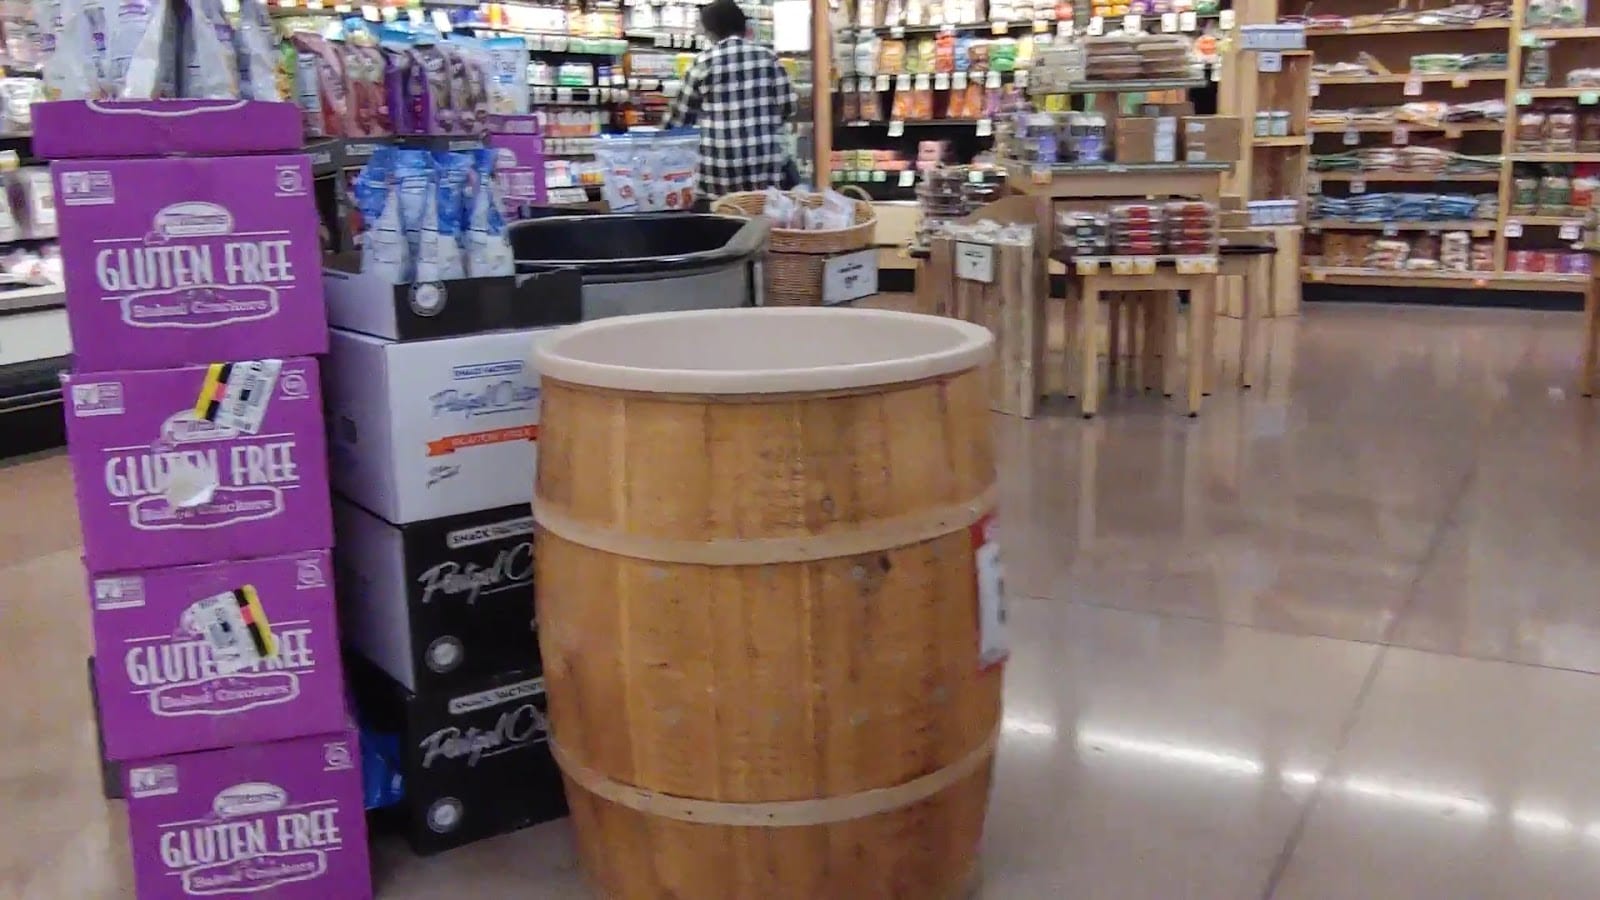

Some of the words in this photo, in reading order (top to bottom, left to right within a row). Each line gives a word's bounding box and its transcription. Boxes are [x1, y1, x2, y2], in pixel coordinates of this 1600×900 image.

[96, 244, 214, 292] GLUTEN
[224, 240, 296, 285] FREE
[104, 449, 219, 498] GLUN
[230, 441, 300, 486] FREE
[124, 639, 220, 686] GLUTE
[160, 818, 267, 870] GLUTEN
[276, 808, 343, 851] FREE
